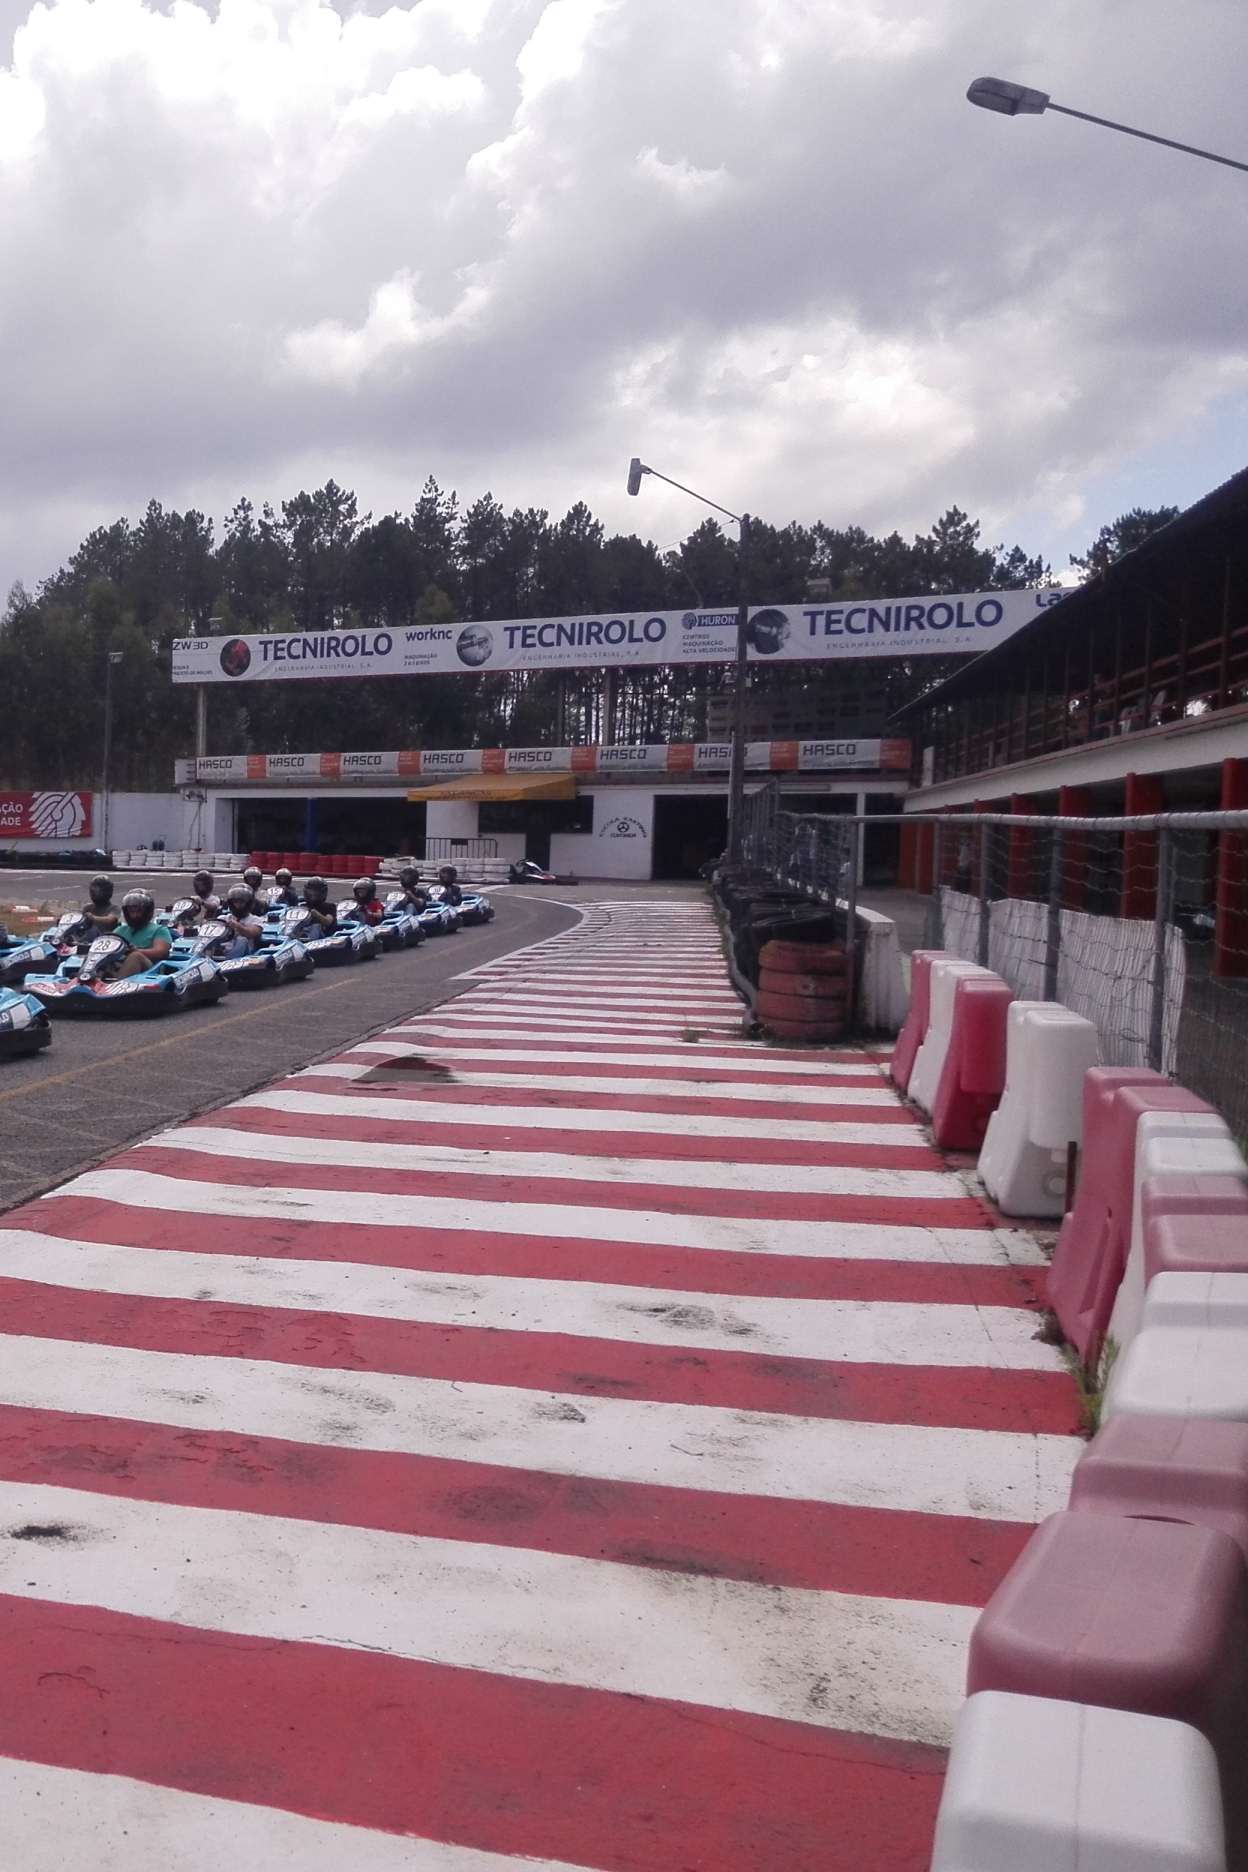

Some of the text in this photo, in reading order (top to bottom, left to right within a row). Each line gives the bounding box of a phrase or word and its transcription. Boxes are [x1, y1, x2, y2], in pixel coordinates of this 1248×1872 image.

[702, 615, 736, 625] HURON
[803, 599, 1004, 636] TECNIROLO
[404, 627, 453, 642] worknc
[503, 617, 667, 649] TECNIROLO
[258, 632, 393, 662] TECNIROLO
[600, 749, 647, 760] HASCO
[698, 746, 748, 758] HAS
[803, 743, 857, 756] HASCO
[269, 757, 305, 768] HASCO
[343, 755, 383, 766] HASCO
[424, 753, 464, 764] HASCO
[508, 751, 552, 763] HASCO
[198, 759, 233, 769] HASCO
[95, 940, 112, 951] 28
